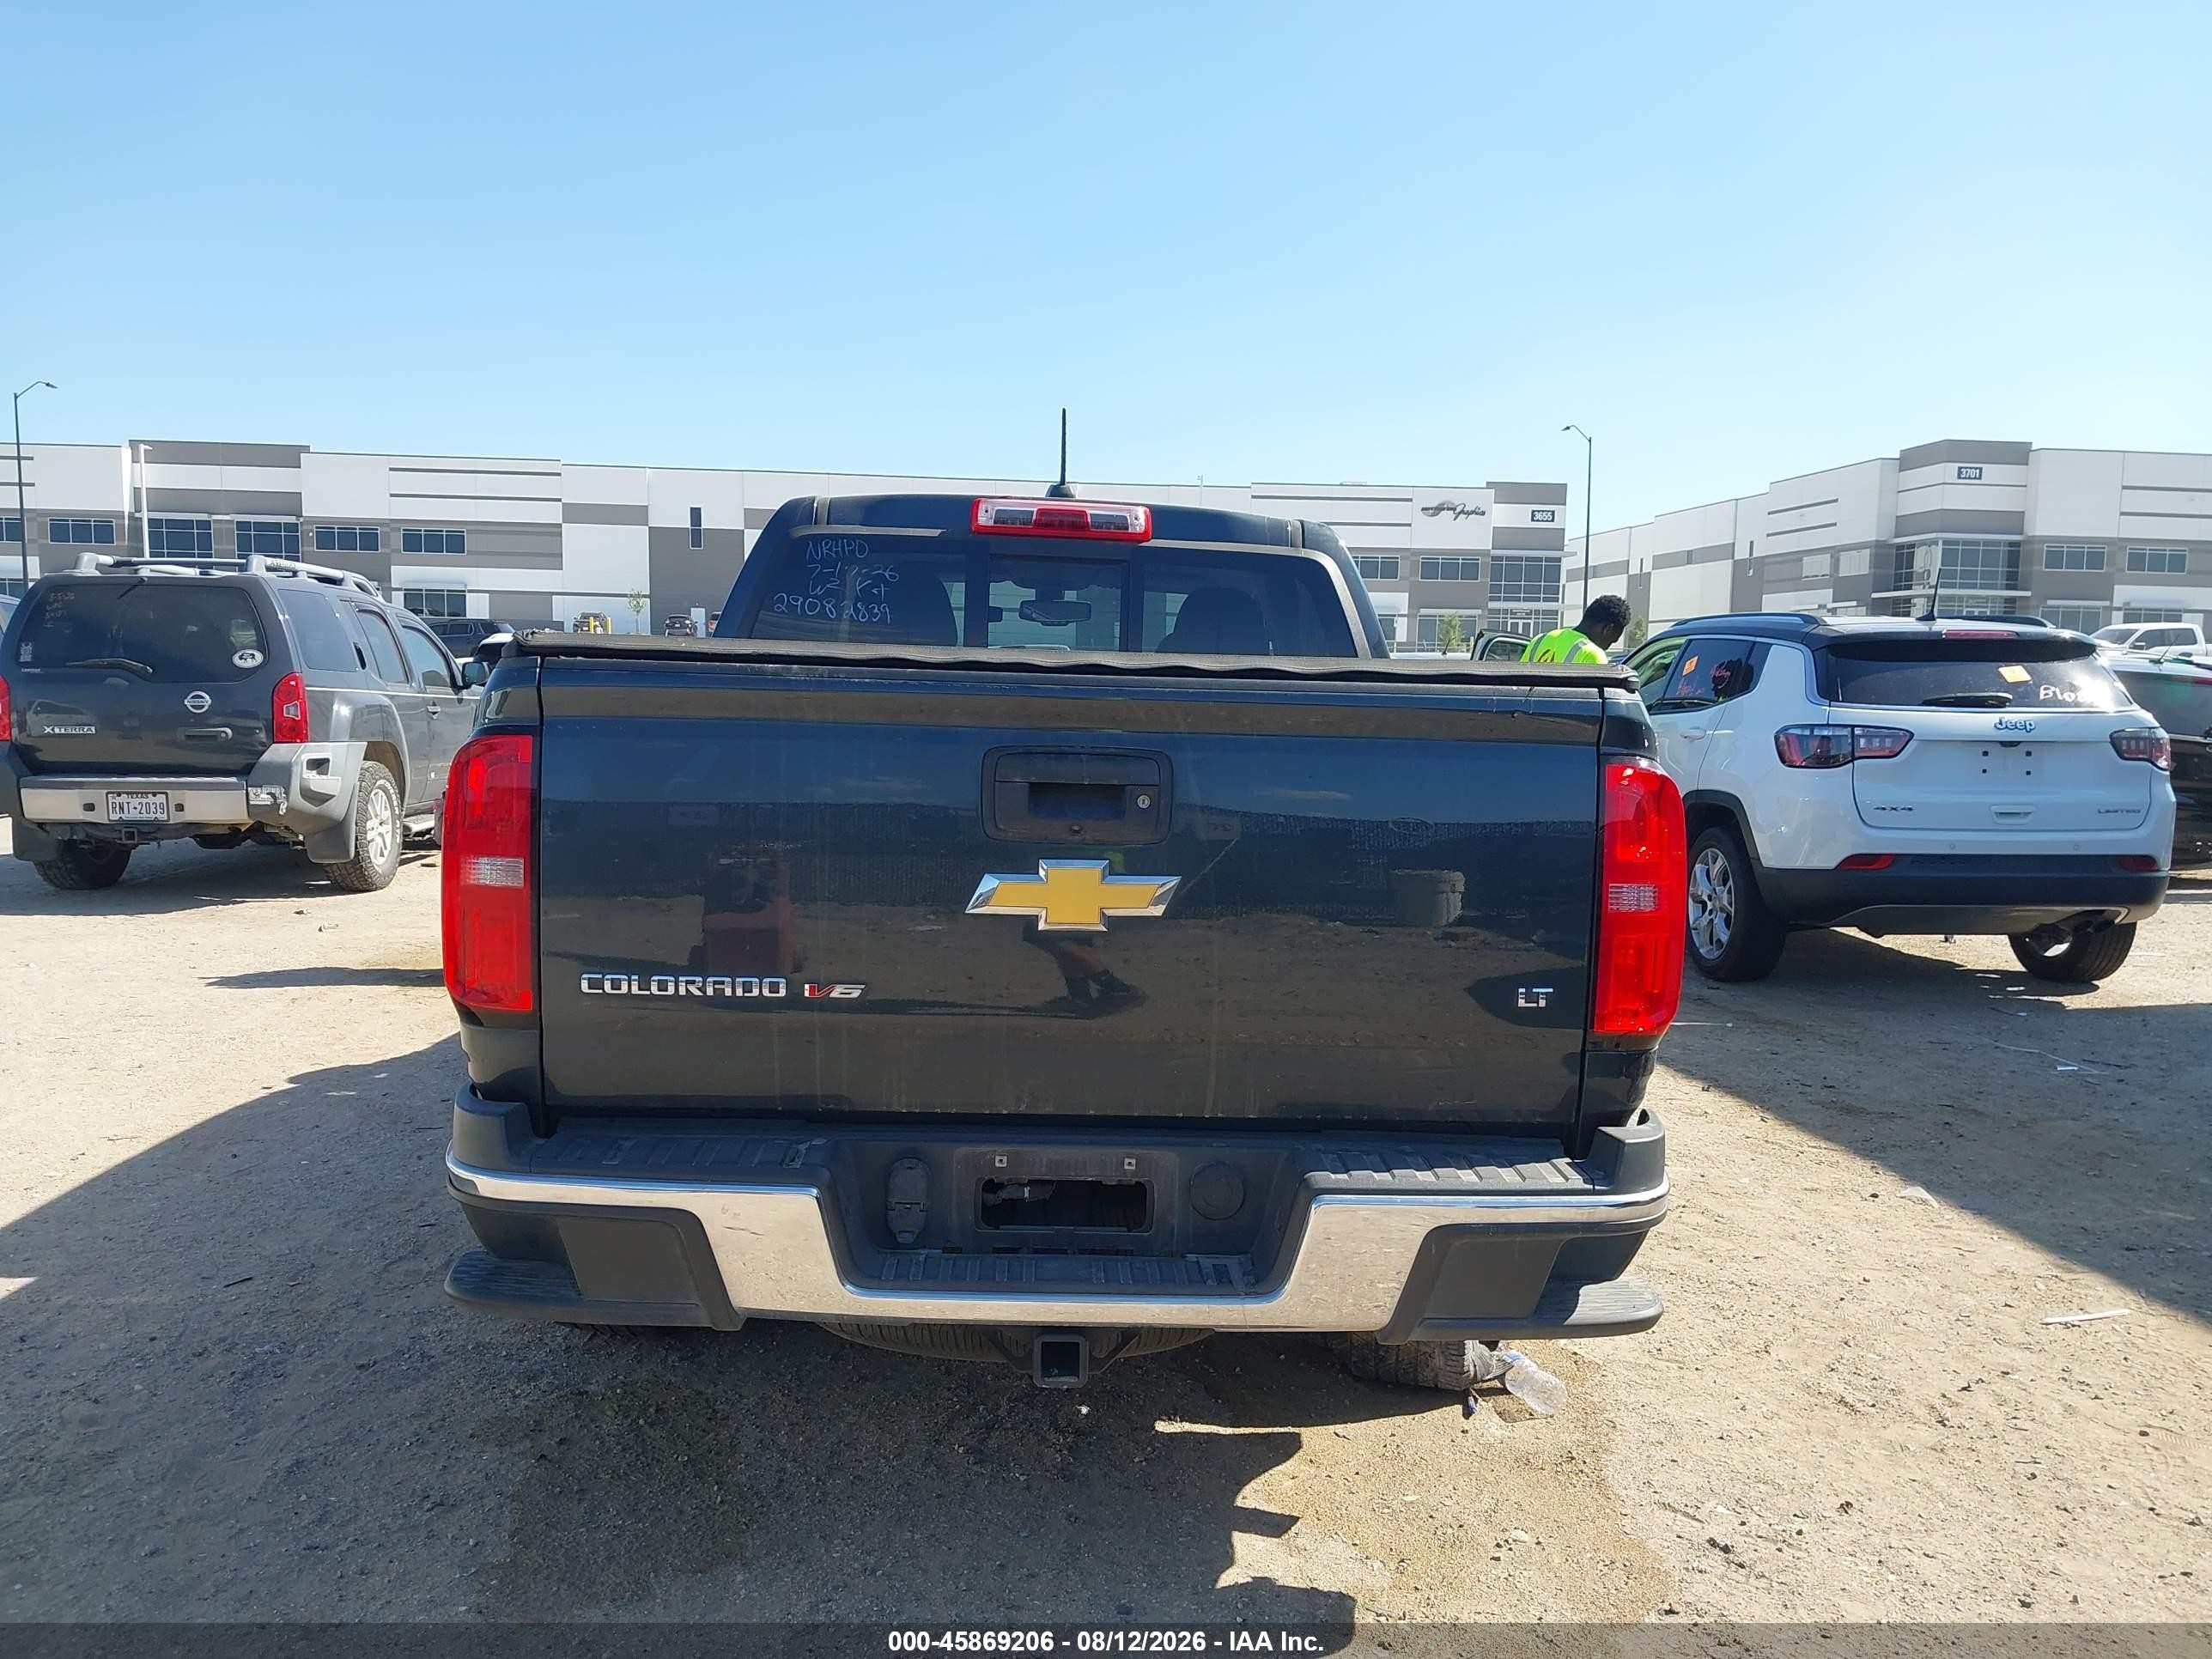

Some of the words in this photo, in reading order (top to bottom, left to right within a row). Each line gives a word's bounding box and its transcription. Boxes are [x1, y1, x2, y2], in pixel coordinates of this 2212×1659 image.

[1960, 467, 1980, 478] 3701
[1533, 511, 1553, 521] 3655
[43, 725, 96, 734] XTERRA
[1994, 716, 2036, 732] Jeep
[580, 973, 787, 998] COLORADO
[804, 983, 866, 999] V6
[1517, 988, 1553, 1007] LT
